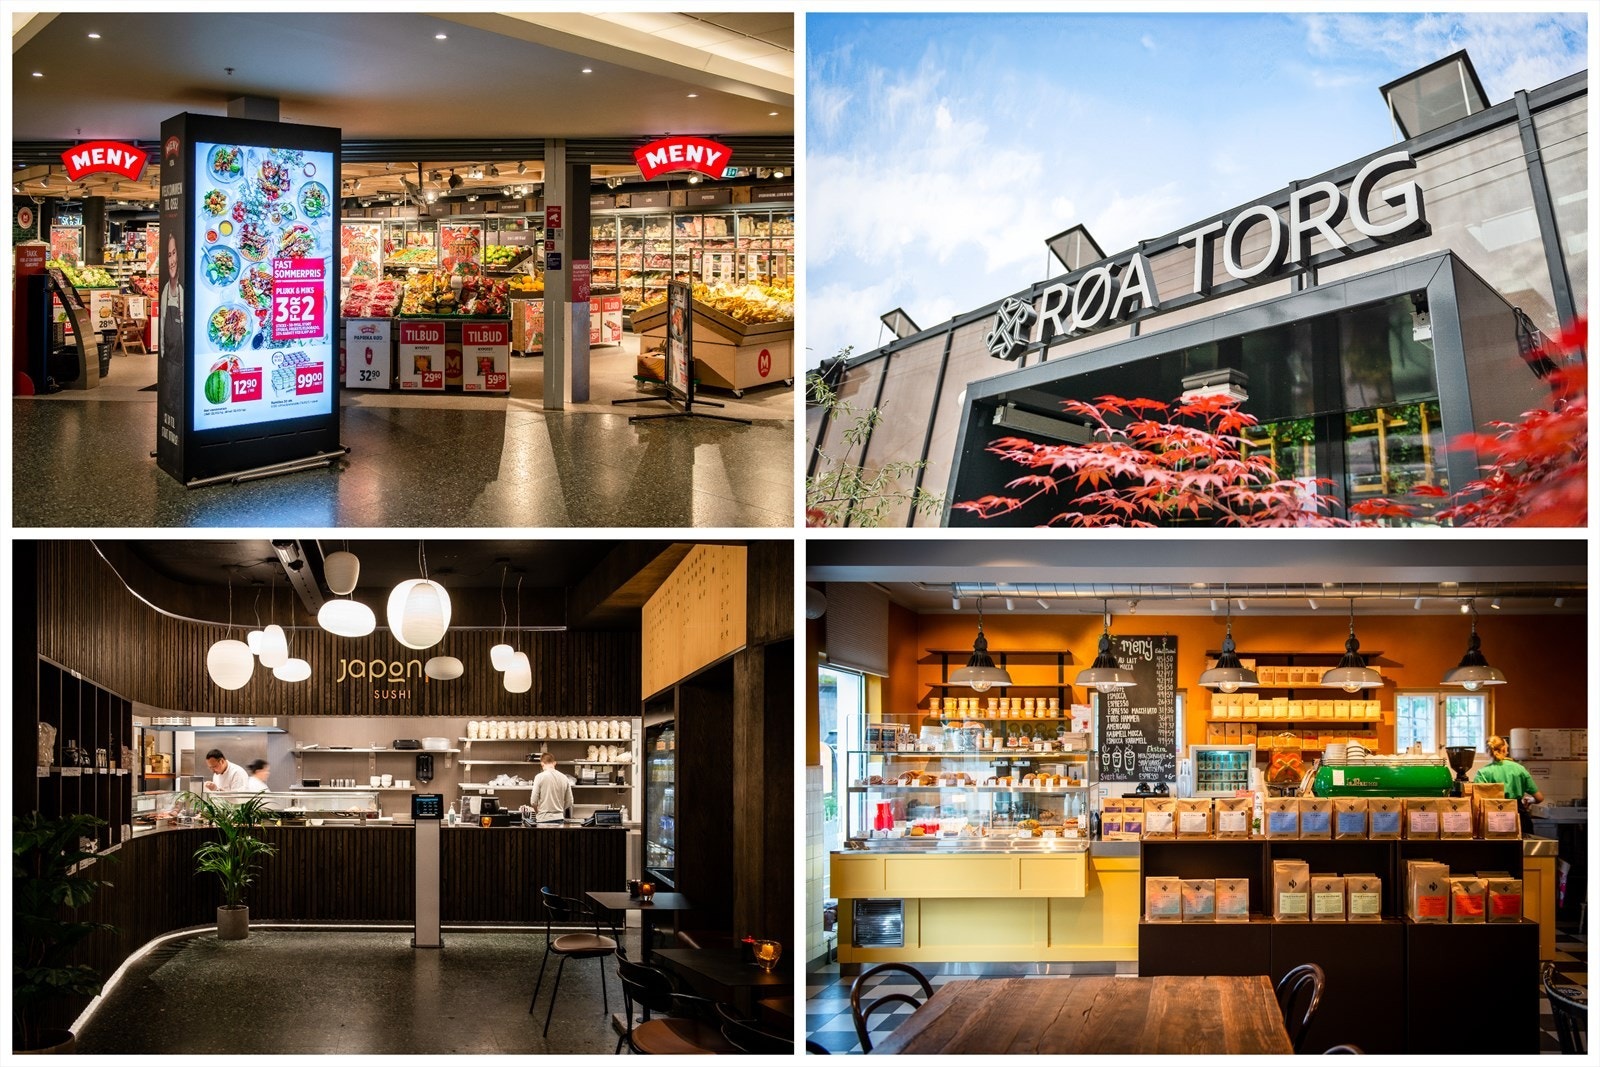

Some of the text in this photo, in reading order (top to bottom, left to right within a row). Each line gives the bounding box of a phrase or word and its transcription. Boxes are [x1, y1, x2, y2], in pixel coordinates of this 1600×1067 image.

[71, 148, 138, 171] MENY
[645, 144, 722, 169] MENY
[1037, 151, 1423, 343] RØA TORG
[274, 260, 292, 269] FAST
[274, 270, 321, 278] SOMMERPRIS
[276, 296, 314, 322] 3 FOR 2
[406, 330, 439, 342] TILBUD
[468, 331, 502, 343] TILBUD
[234, 379, 258, 394] 1290
[298, 372, 322, 388] 9900
[1120, 640, 1153, 661] meny
[337, 659, 424, 682] japon
[374, 690, 411, 699] SUSHI
